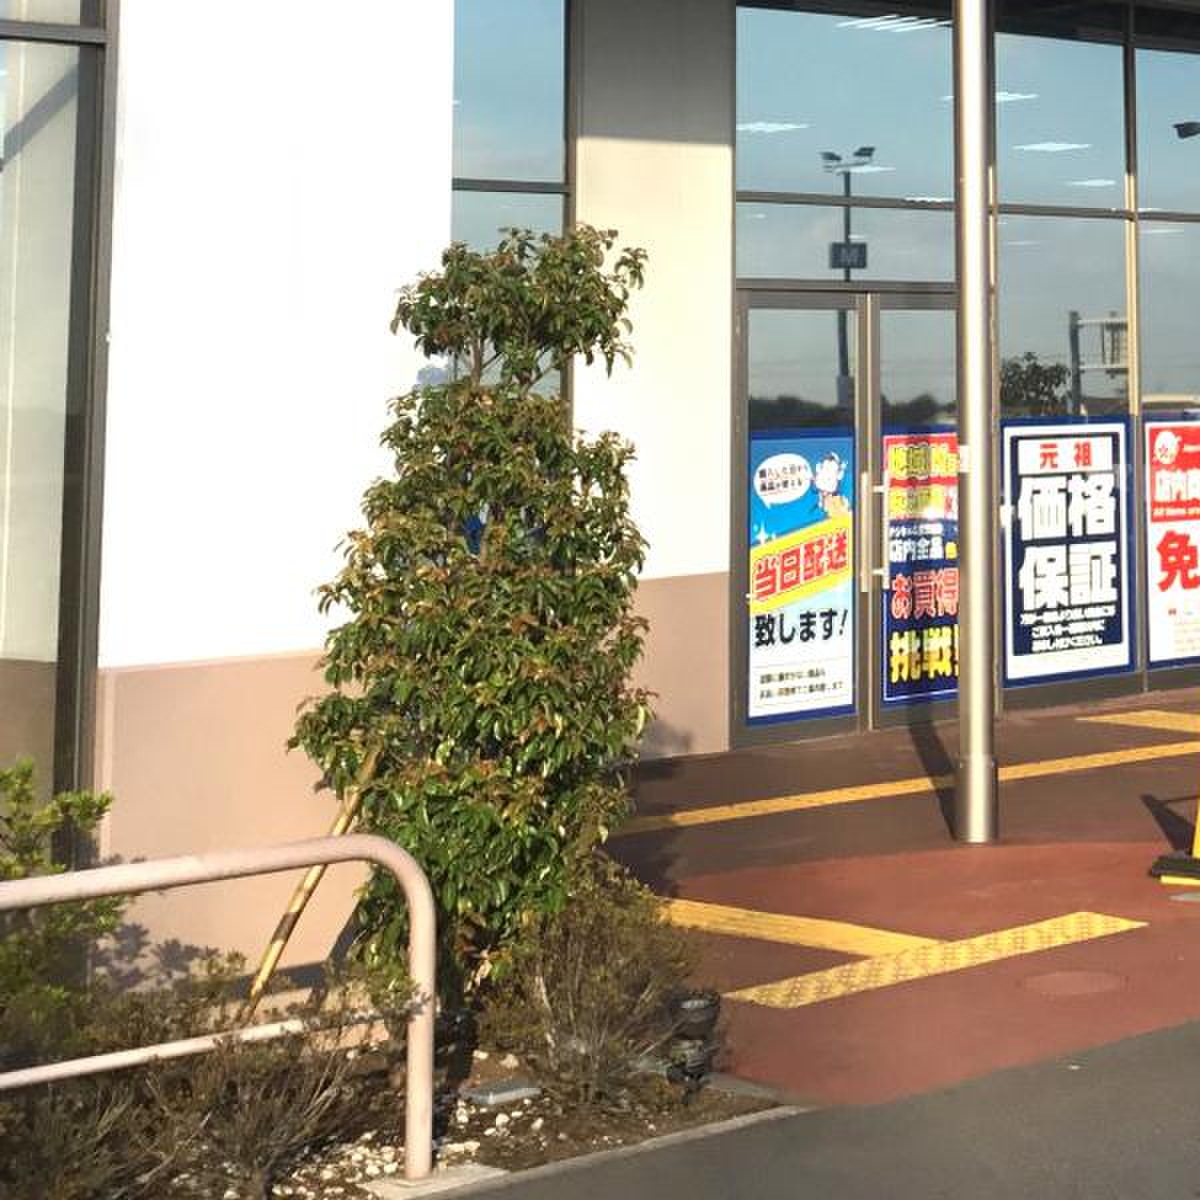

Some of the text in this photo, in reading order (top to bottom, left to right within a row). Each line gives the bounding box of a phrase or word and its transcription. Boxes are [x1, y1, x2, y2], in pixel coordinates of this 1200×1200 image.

[1039, 441, 1093, 469] 元祖
[1018, 472, 1116, 541] 価格
[753, 529, 849, 601] 当日配送
[1019, 541, 1117, 612] 保証
